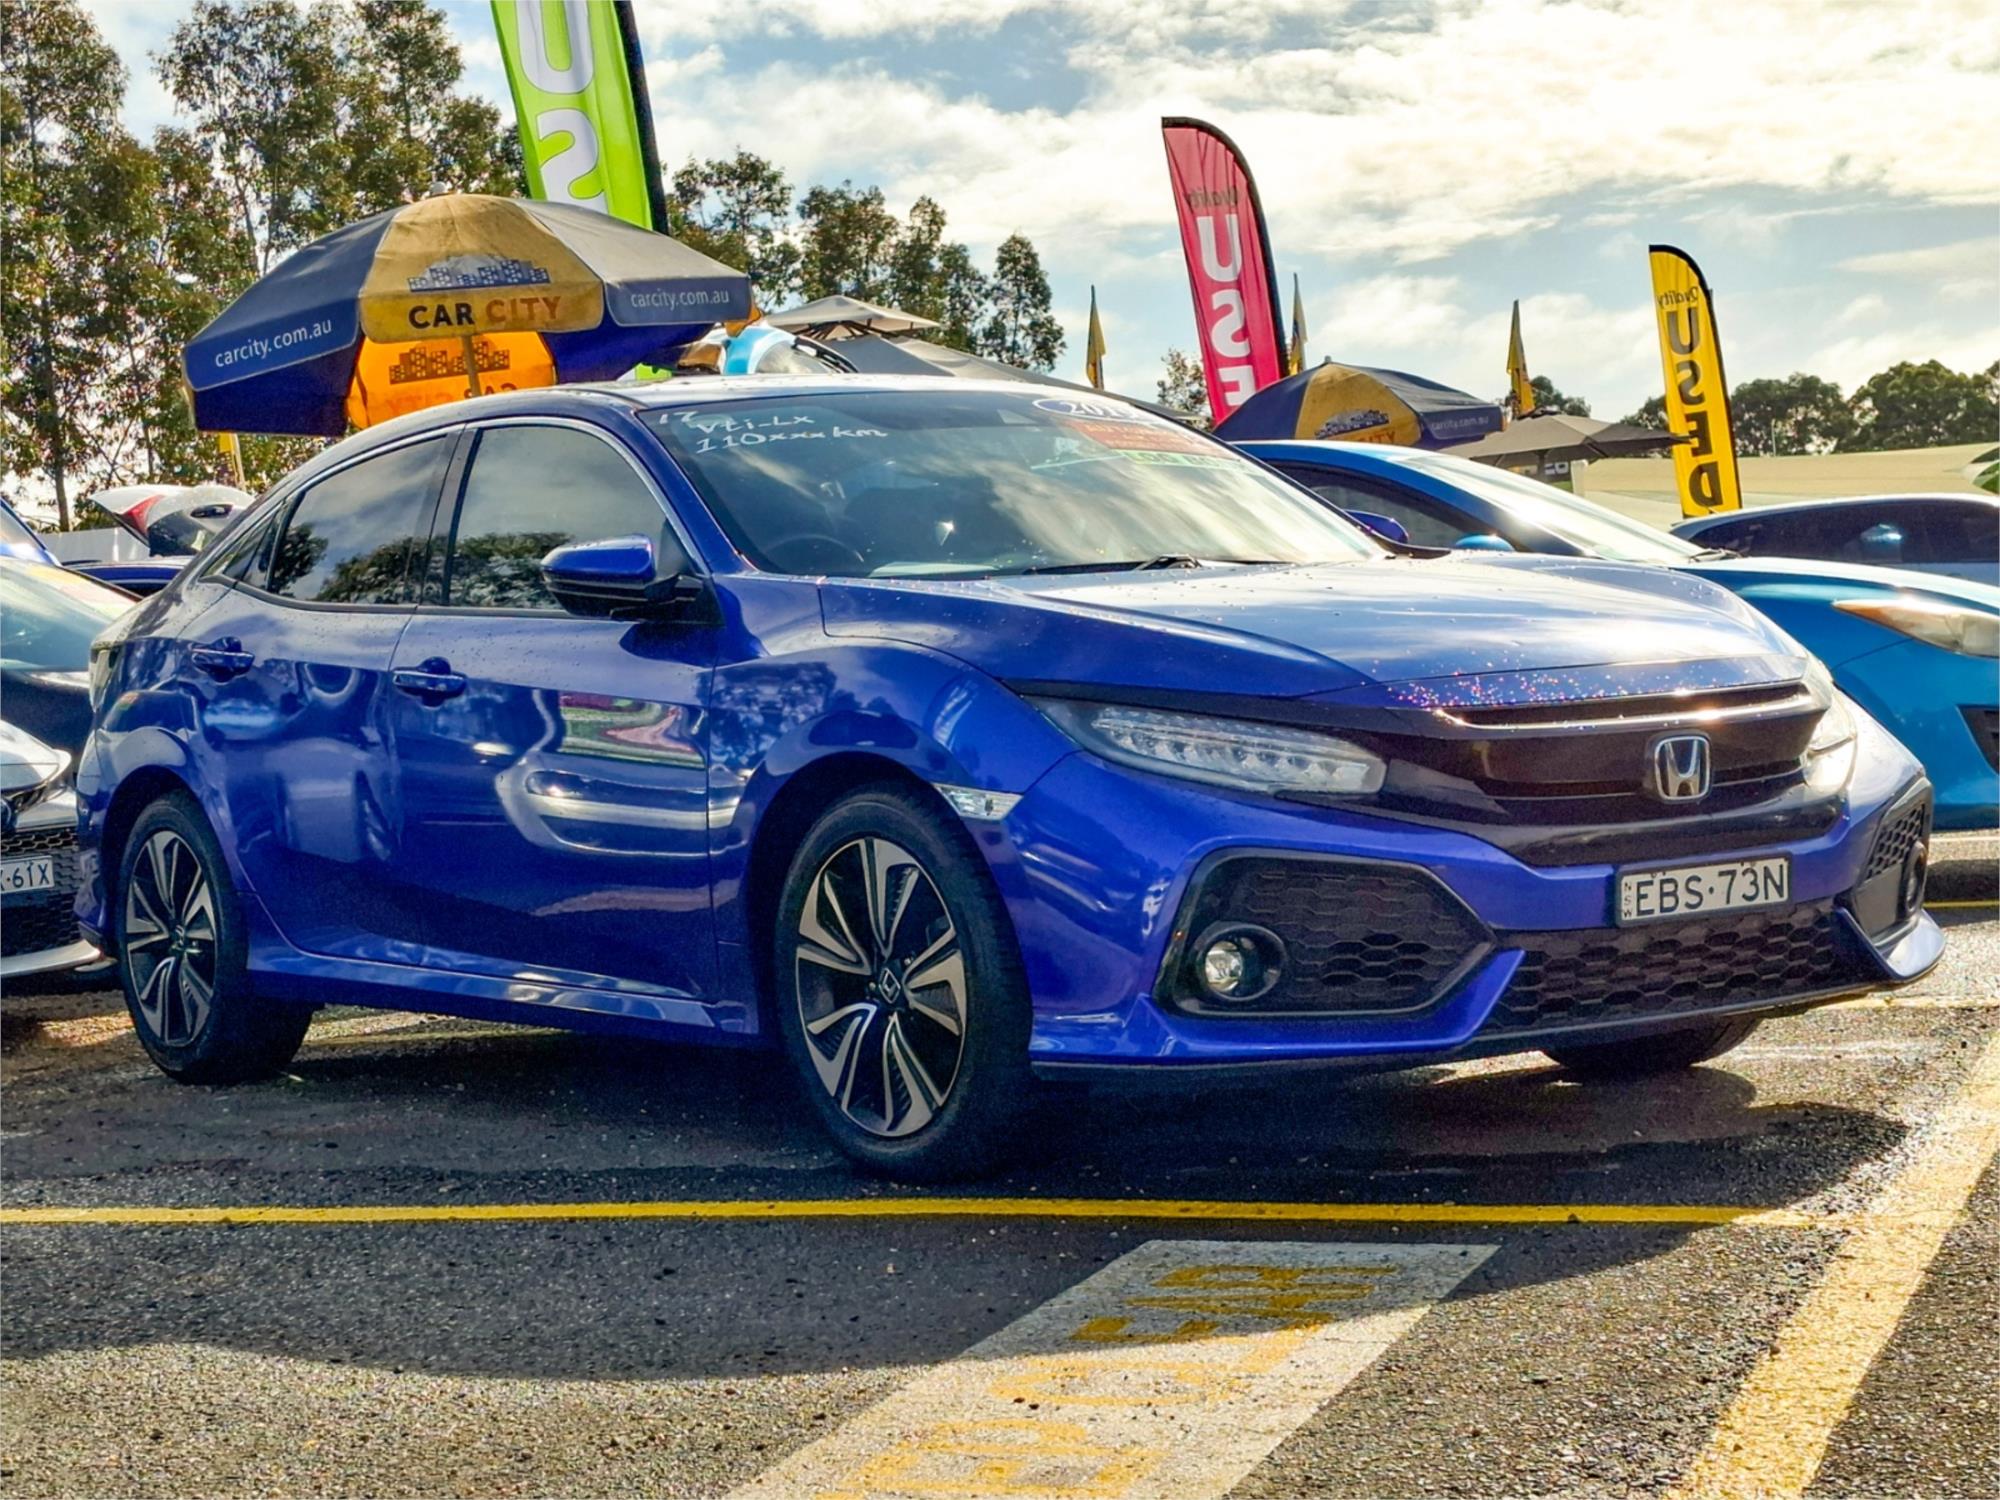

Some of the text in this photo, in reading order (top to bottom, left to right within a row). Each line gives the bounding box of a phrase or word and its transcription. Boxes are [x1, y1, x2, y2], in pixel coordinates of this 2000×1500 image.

[408, 296, 561, 329] CAR CITY
[630, 288, 729, 311] carcity.com.au
[214, 319, 332, 368] carcity.com.au
[832, 426, 888, 438] km
